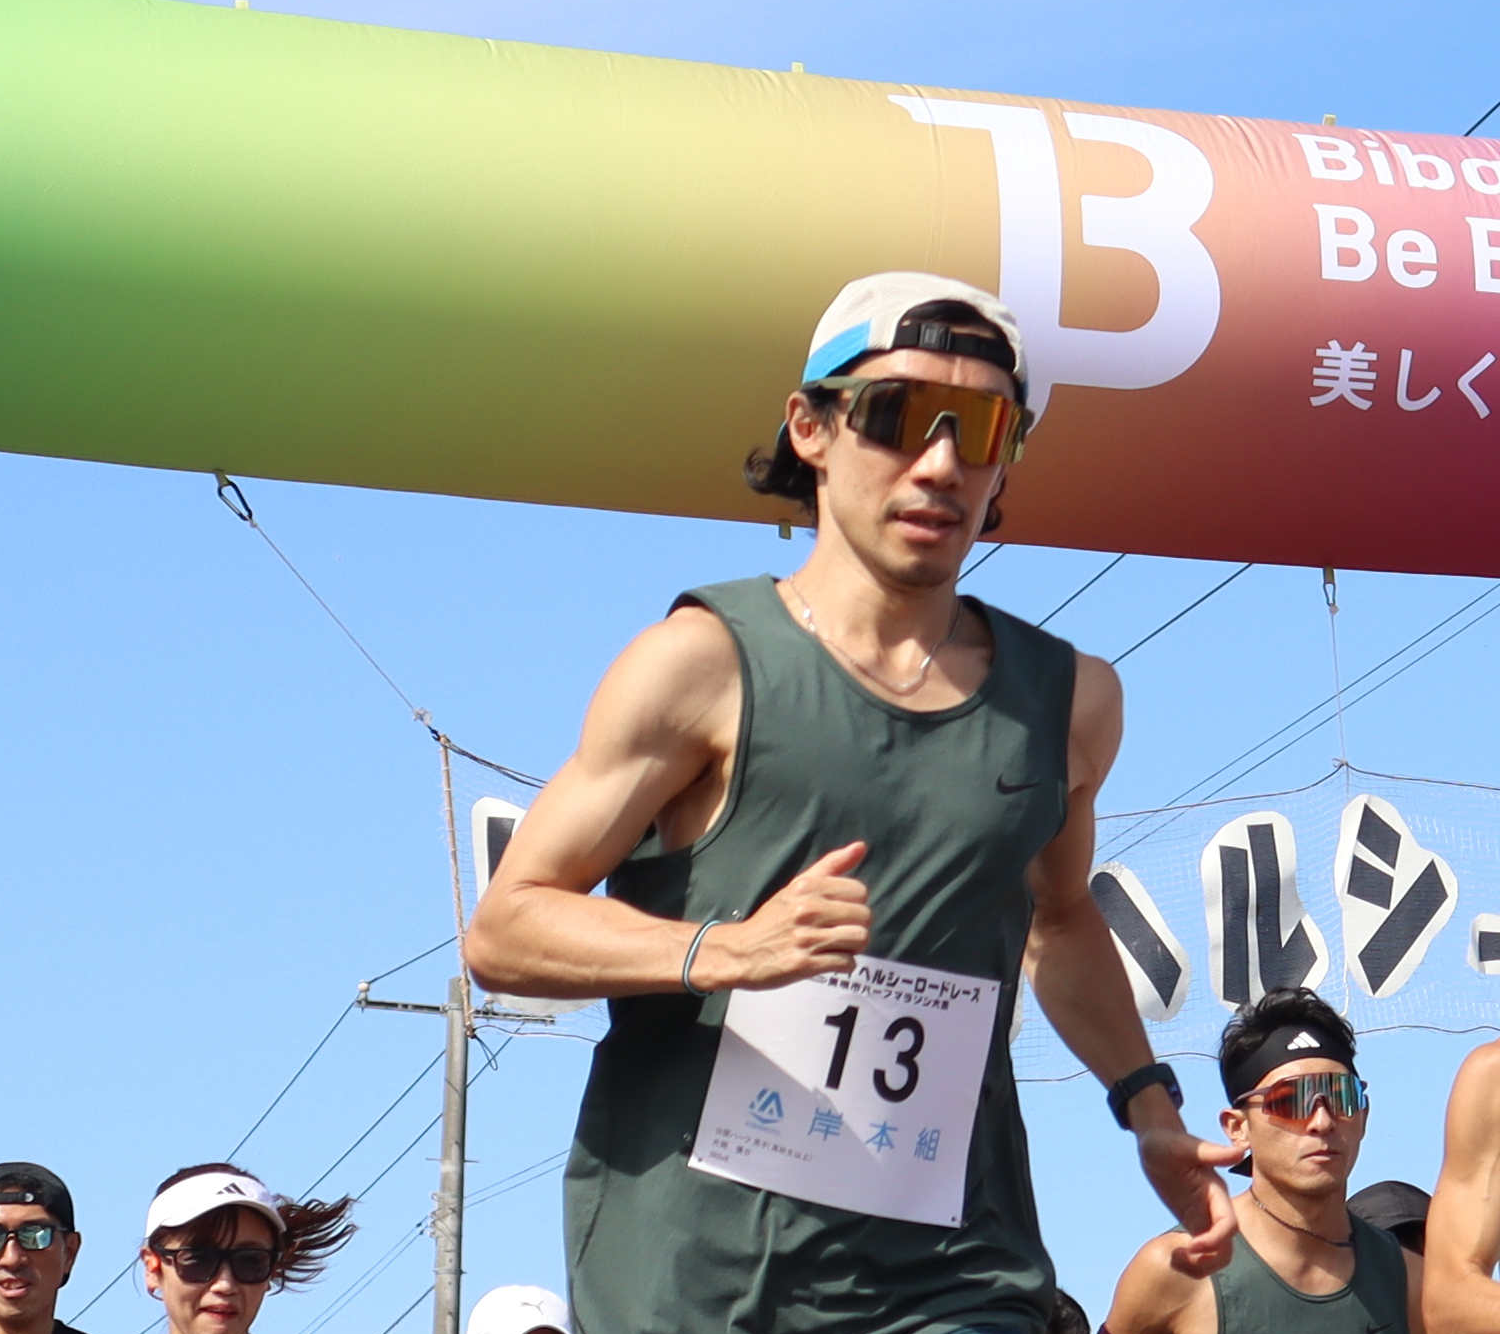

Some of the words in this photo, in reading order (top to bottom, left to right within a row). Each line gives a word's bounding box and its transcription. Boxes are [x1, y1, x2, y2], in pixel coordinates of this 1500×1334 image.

[1311, 202, 1438, 290] Be
[857, 966, 981, 1003] ヘルシーロードレース
[823, 1005, 925, 1103] 13
[808, 1108, 942, 1162] 岸本組
